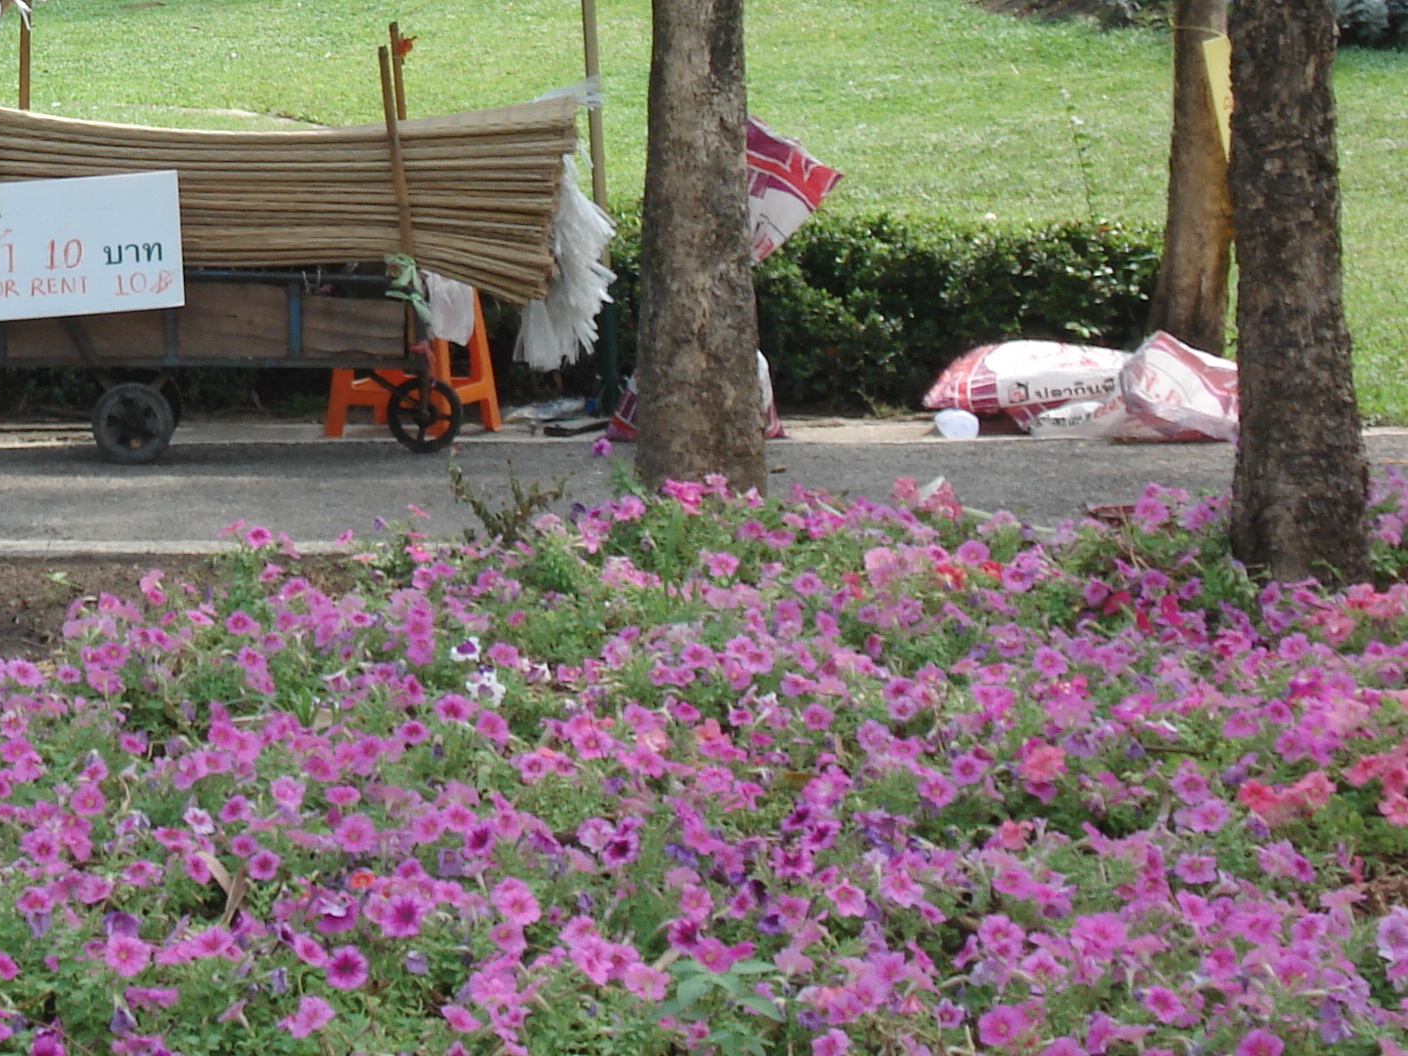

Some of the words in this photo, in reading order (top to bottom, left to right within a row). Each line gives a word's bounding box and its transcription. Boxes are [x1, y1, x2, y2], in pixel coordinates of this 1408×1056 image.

[45, 238, 83, 270] 10
[103, 241, 163, 266] บาท
[30, 275, 90, 297] RENT
